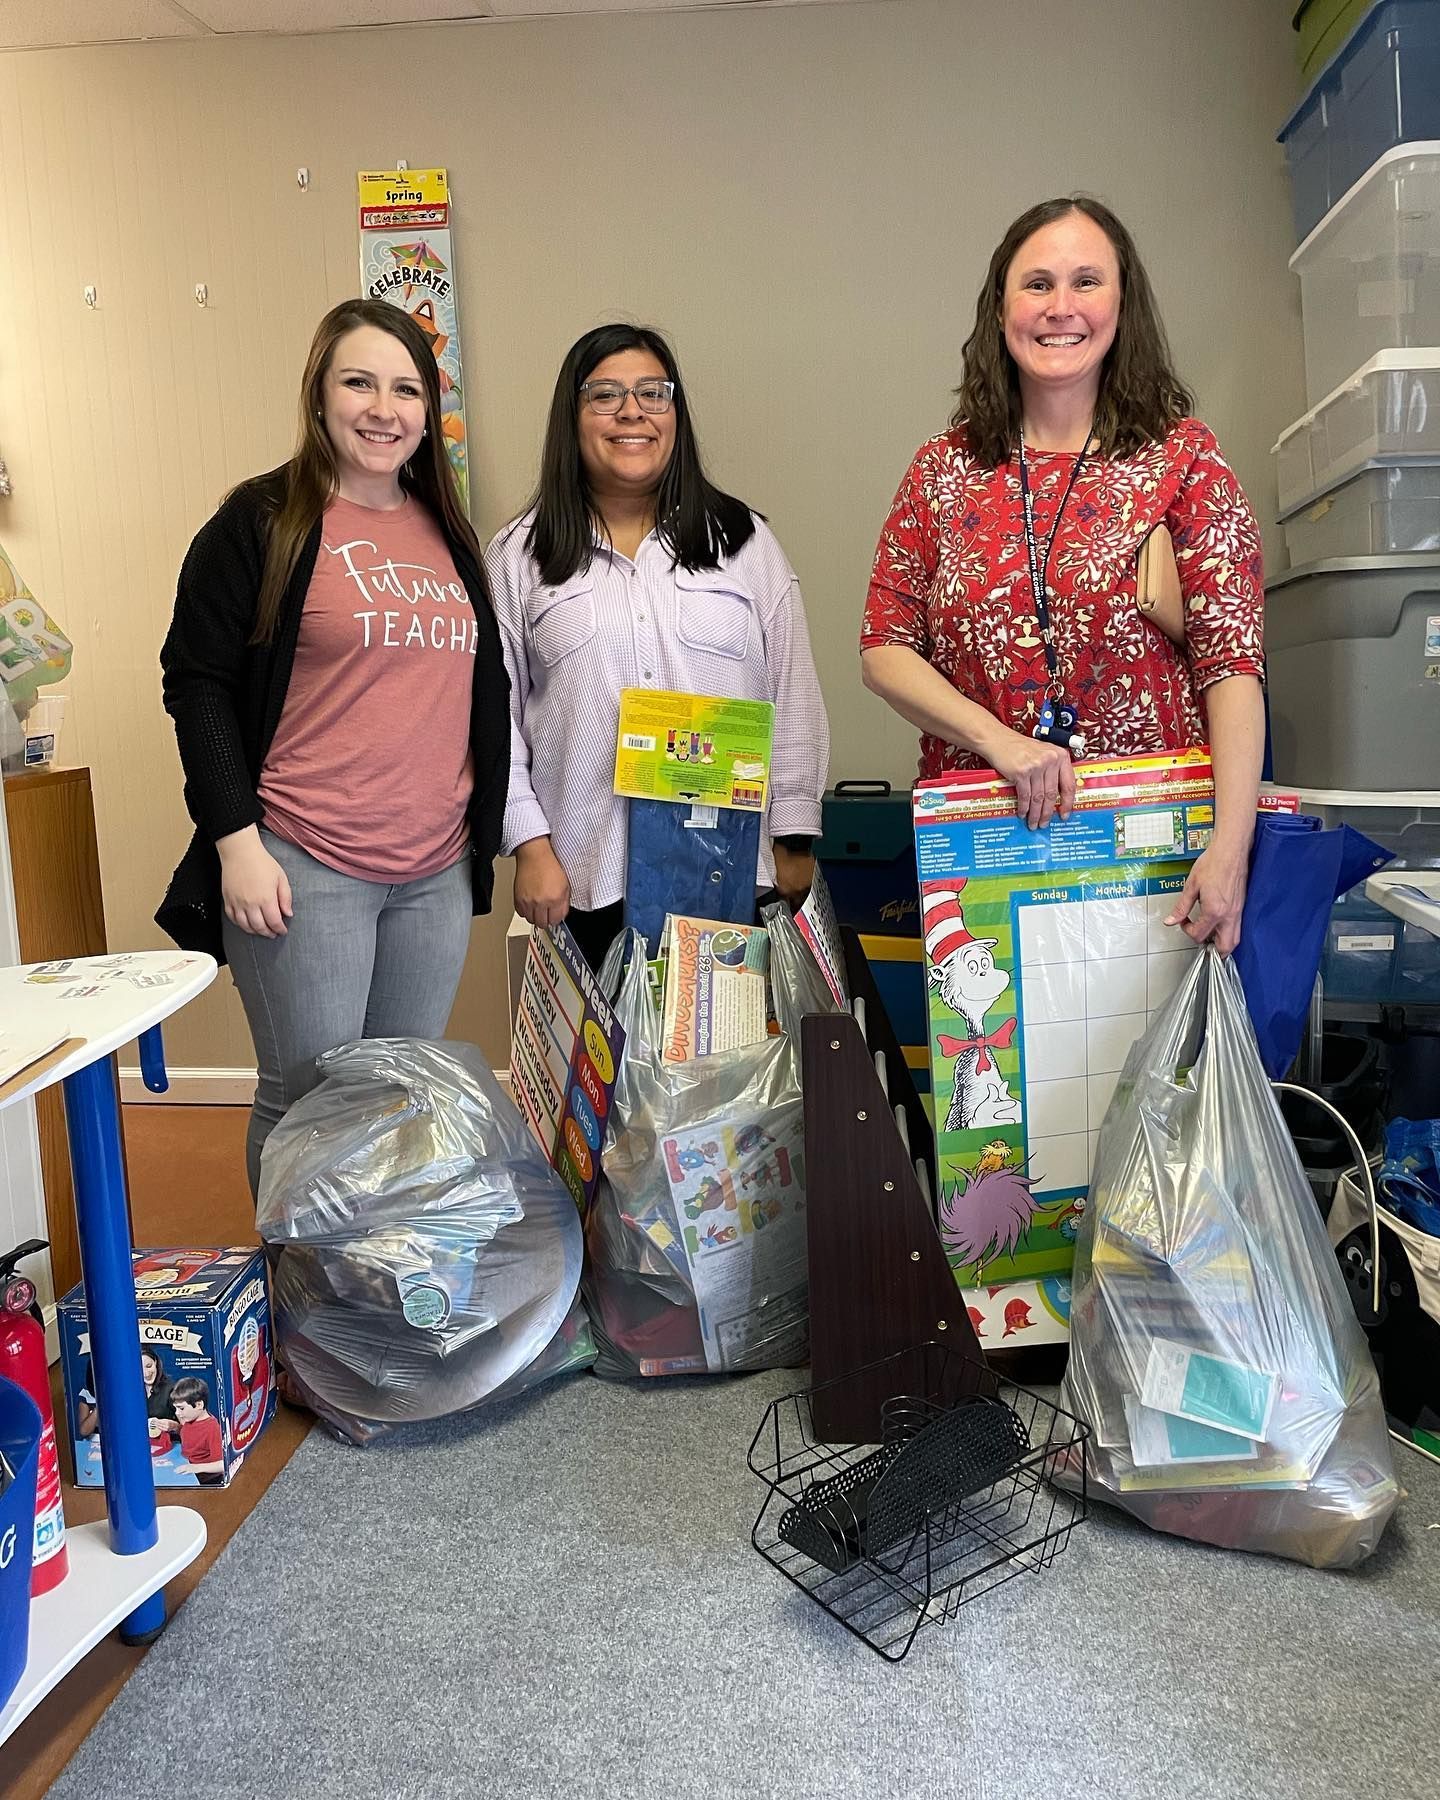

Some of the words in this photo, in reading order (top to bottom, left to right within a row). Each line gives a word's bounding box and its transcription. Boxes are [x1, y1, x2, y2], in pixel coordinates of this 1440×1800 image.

[386, 189, 423, 203] Spring
[369, 266, 451, 299] CELEBRATE
[1025, 493, 1033, 533] UNIVERSITY
[1029, 534, 1035, 545] OF
[324, 540, 469, 604] Future
[1029, 546, 1037, 570] NORTH
[963, 811, 992, 819] calendario
[1261, 797, 1277, 805] 133
[1031, 889, 1068, 901] Sunday
[1095, 883, 1134, 896] Monday
[533, 925, 560, 988] Sunday
[699, 956, 711, 974] 66
[528, 956, 557, 1026] Monday
[565, 946, 573, 958] of
[571, 956, 580, 977] the
[581, 963, 613, 1038] Week
[699, 974, 710, 1001] World
[524, 985, 551, 1057] Tuesday
[699, 1002, 708, 1019] the
[589, 1033, 606, 1073] Sun.
[698, 1020, 710, 1056] Imagine
[518, 1014, 559, 1114] Wednesday
[510, 1071, 530, 1126] Friday
[514, 1045, 544, 1124] Thursday
[581, 1063, 601, 1108] Mon.
[576, 1094, 594, 1142] Tues.
[141, 1287, 191, 1297] BINGO
[145, 1326, 184, 1342] CAGE
